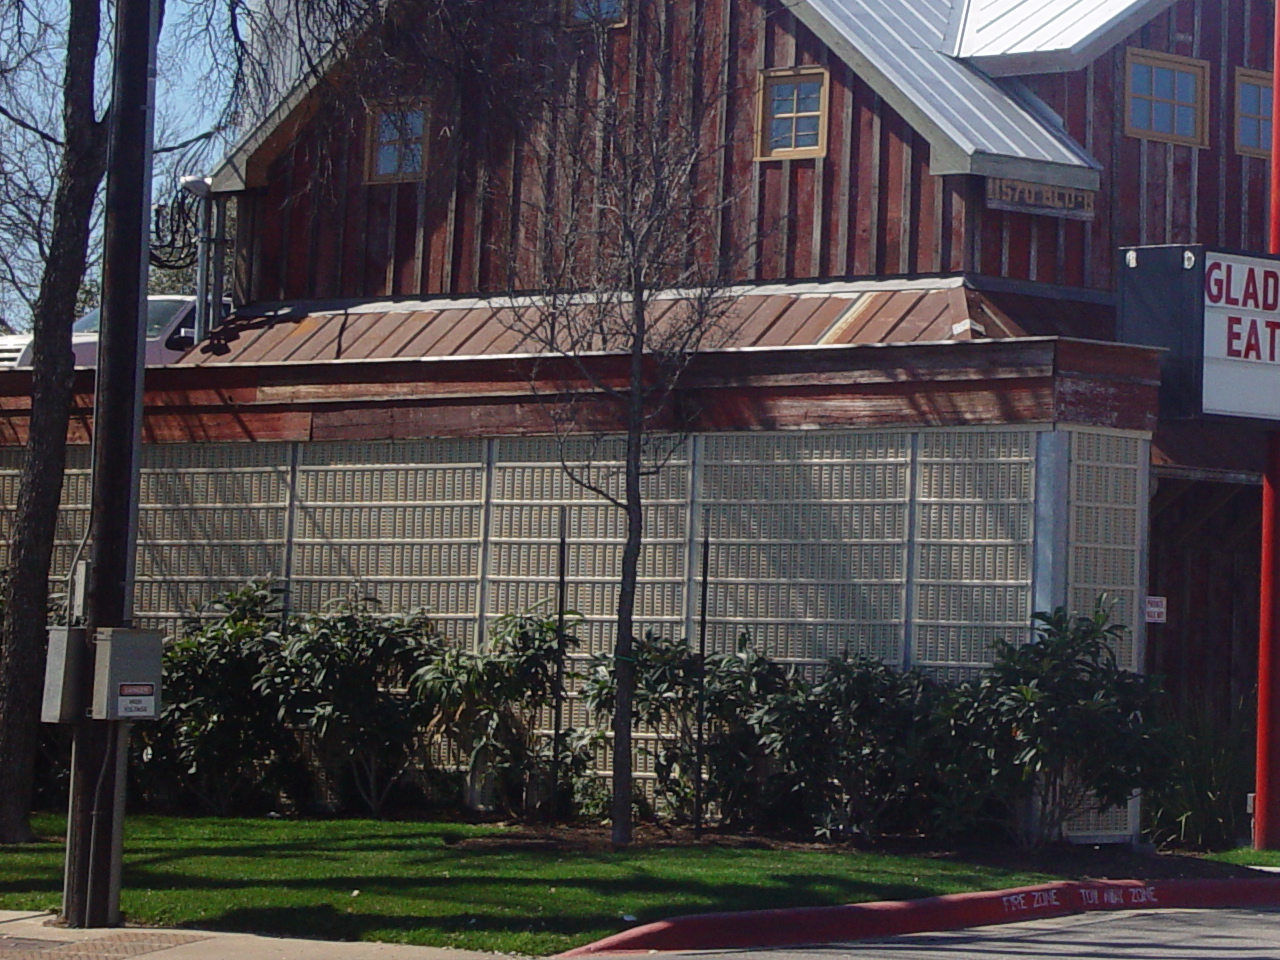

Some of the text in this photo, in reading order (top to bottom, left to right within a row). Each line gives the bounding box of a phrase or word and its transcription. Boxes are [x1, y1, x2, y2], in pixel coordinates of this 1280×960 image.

[1002, 889, 1060, 912] FIRE ZONE
[1129, 886, 1159, 903] ZONE
